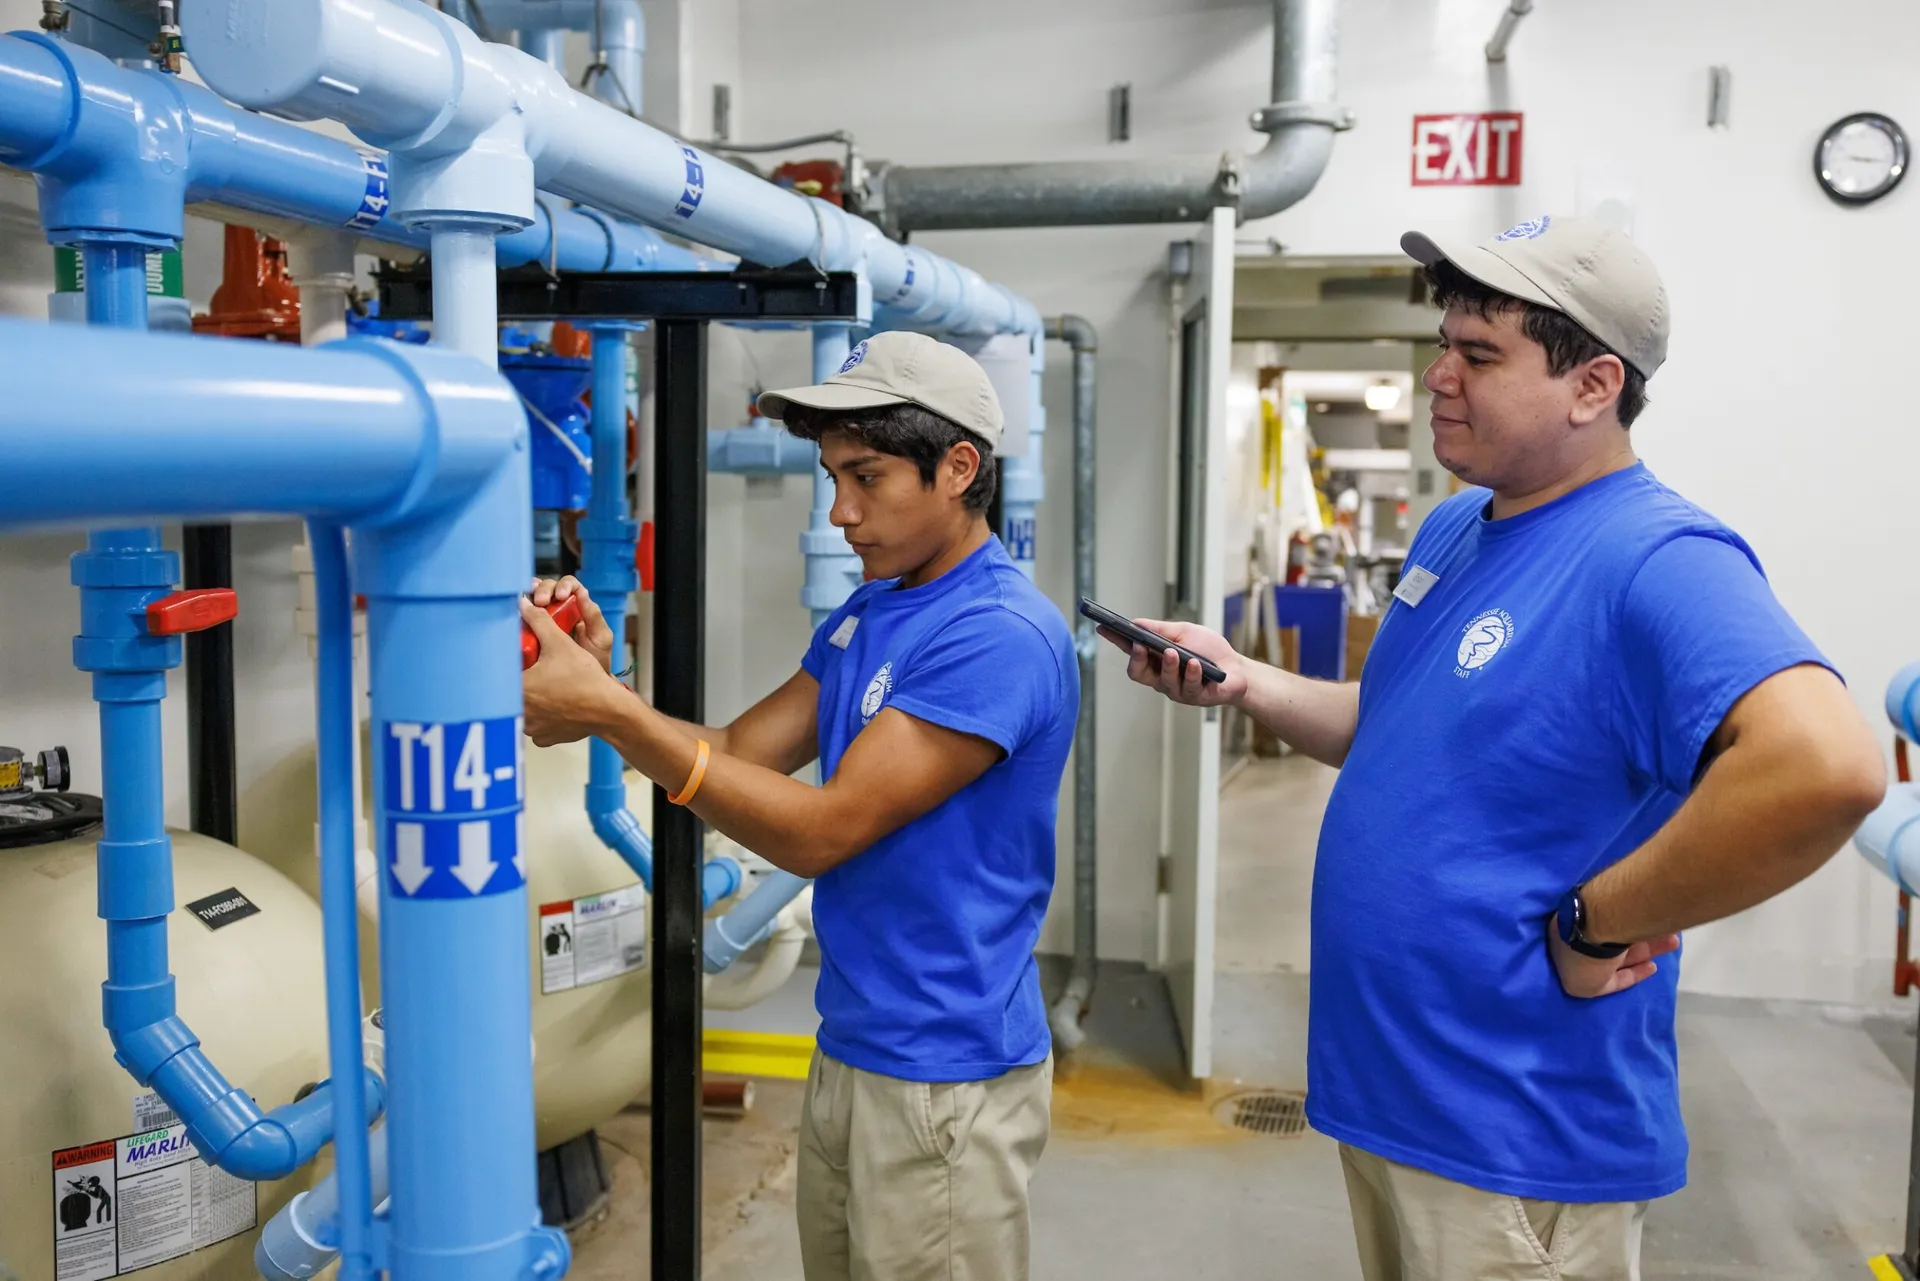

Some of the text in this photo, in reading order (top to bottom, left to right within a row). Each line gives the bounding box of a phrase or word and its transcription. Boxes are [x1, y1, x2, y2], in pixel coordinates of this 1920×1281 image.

[1417, 119, 1518, 179] EXIT
[1462, 608, 1500, 633] TENNESSEE
[1453, 666, 1470, 678] STAFF
[126, 1130, 169, 1148] LIFEGARD
[67, 1144, 113, 1163] WARNING
